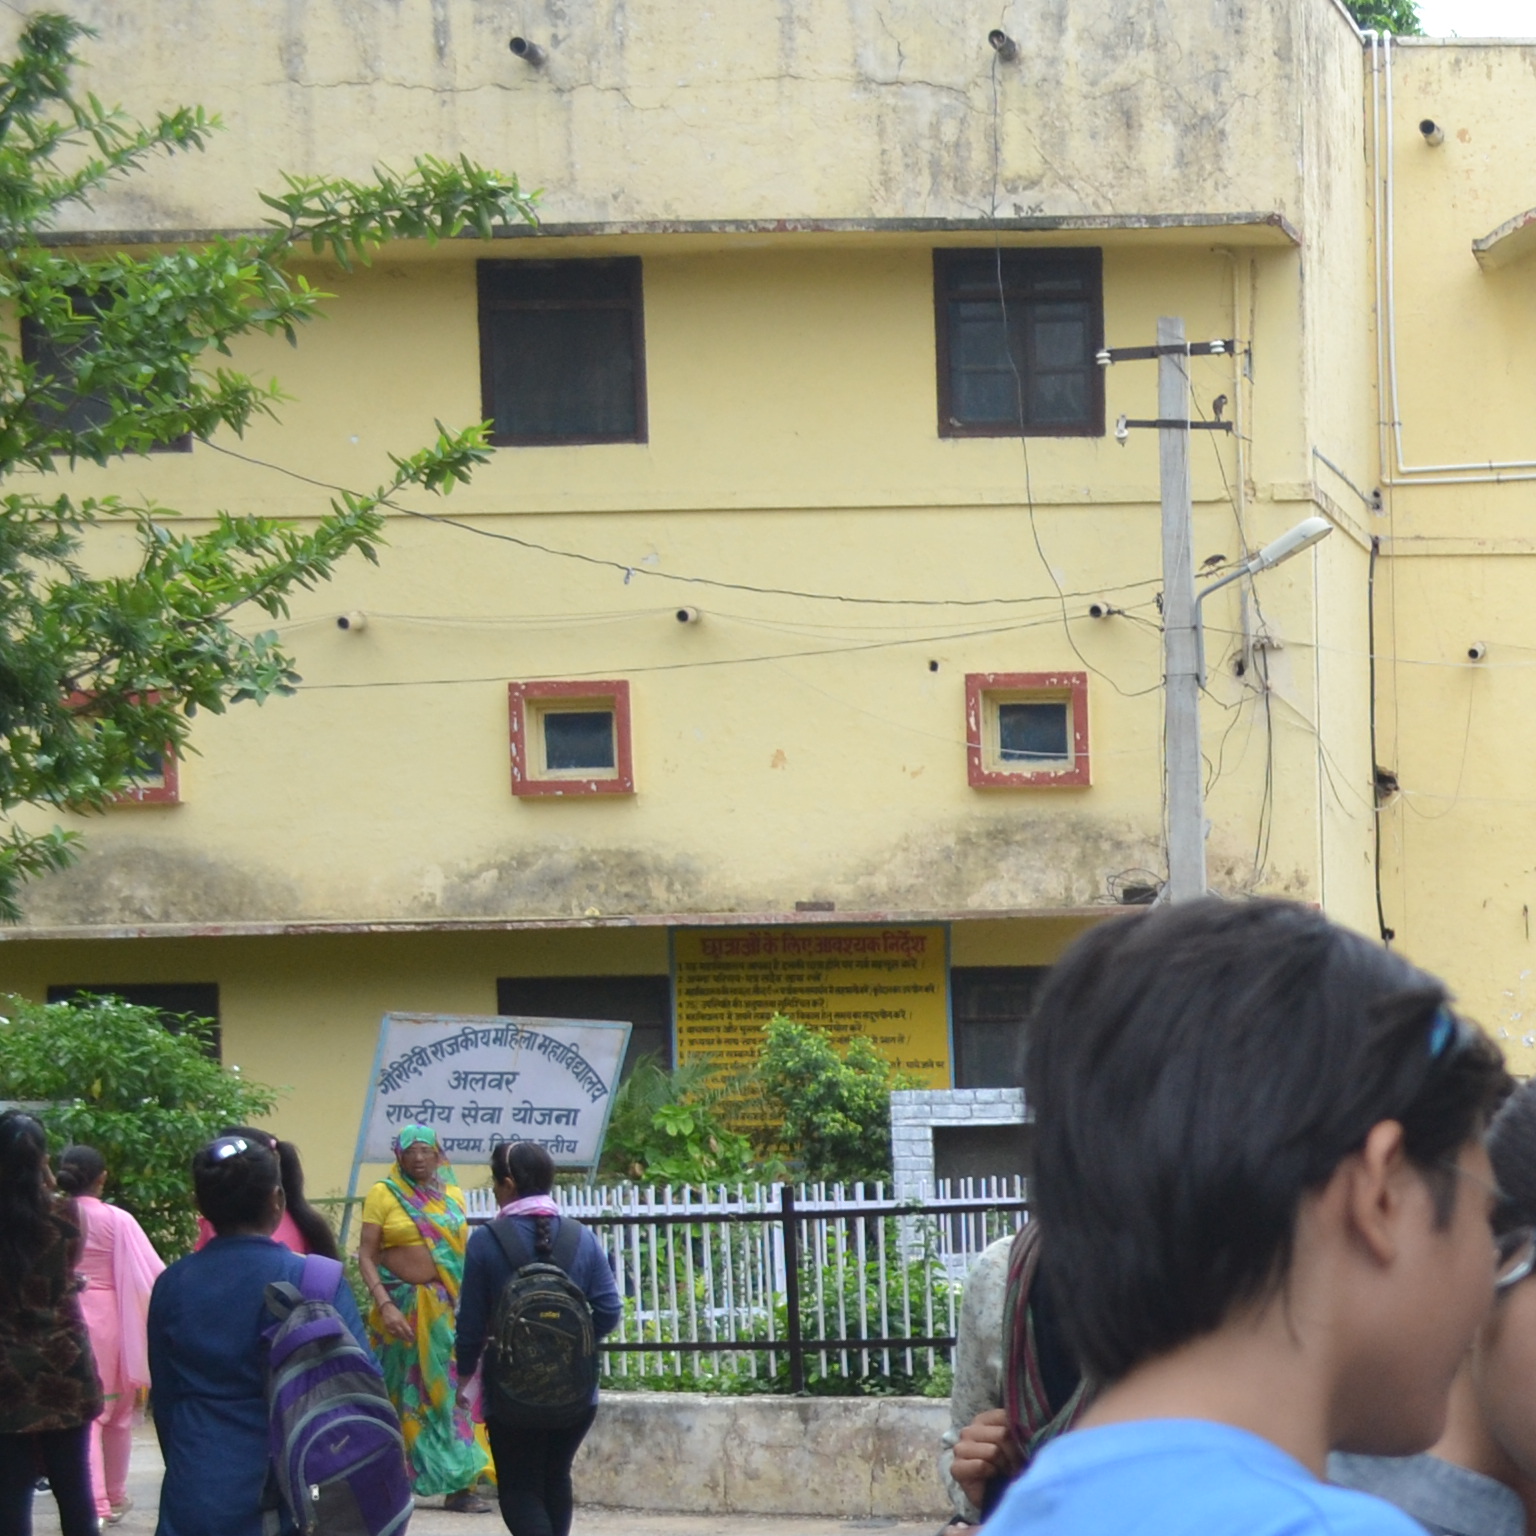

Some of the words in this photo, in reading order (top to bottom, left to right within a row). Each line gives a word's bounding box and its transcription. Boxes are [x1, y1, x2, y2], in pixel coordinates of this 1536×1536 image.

[429, 1026, 491, 1061] राजकीय
[492, 1022, 540, 1051] महिला
[536, 1033, 609, 1104] महाविद्यालय
[448, 1070, 520, 1093] अलवर
[386, 1099, 454, 1125] राष्ट्रीय
[462, 1100, 504, 1127] सेवा
[512, 1100, 581, 1126] योजना
